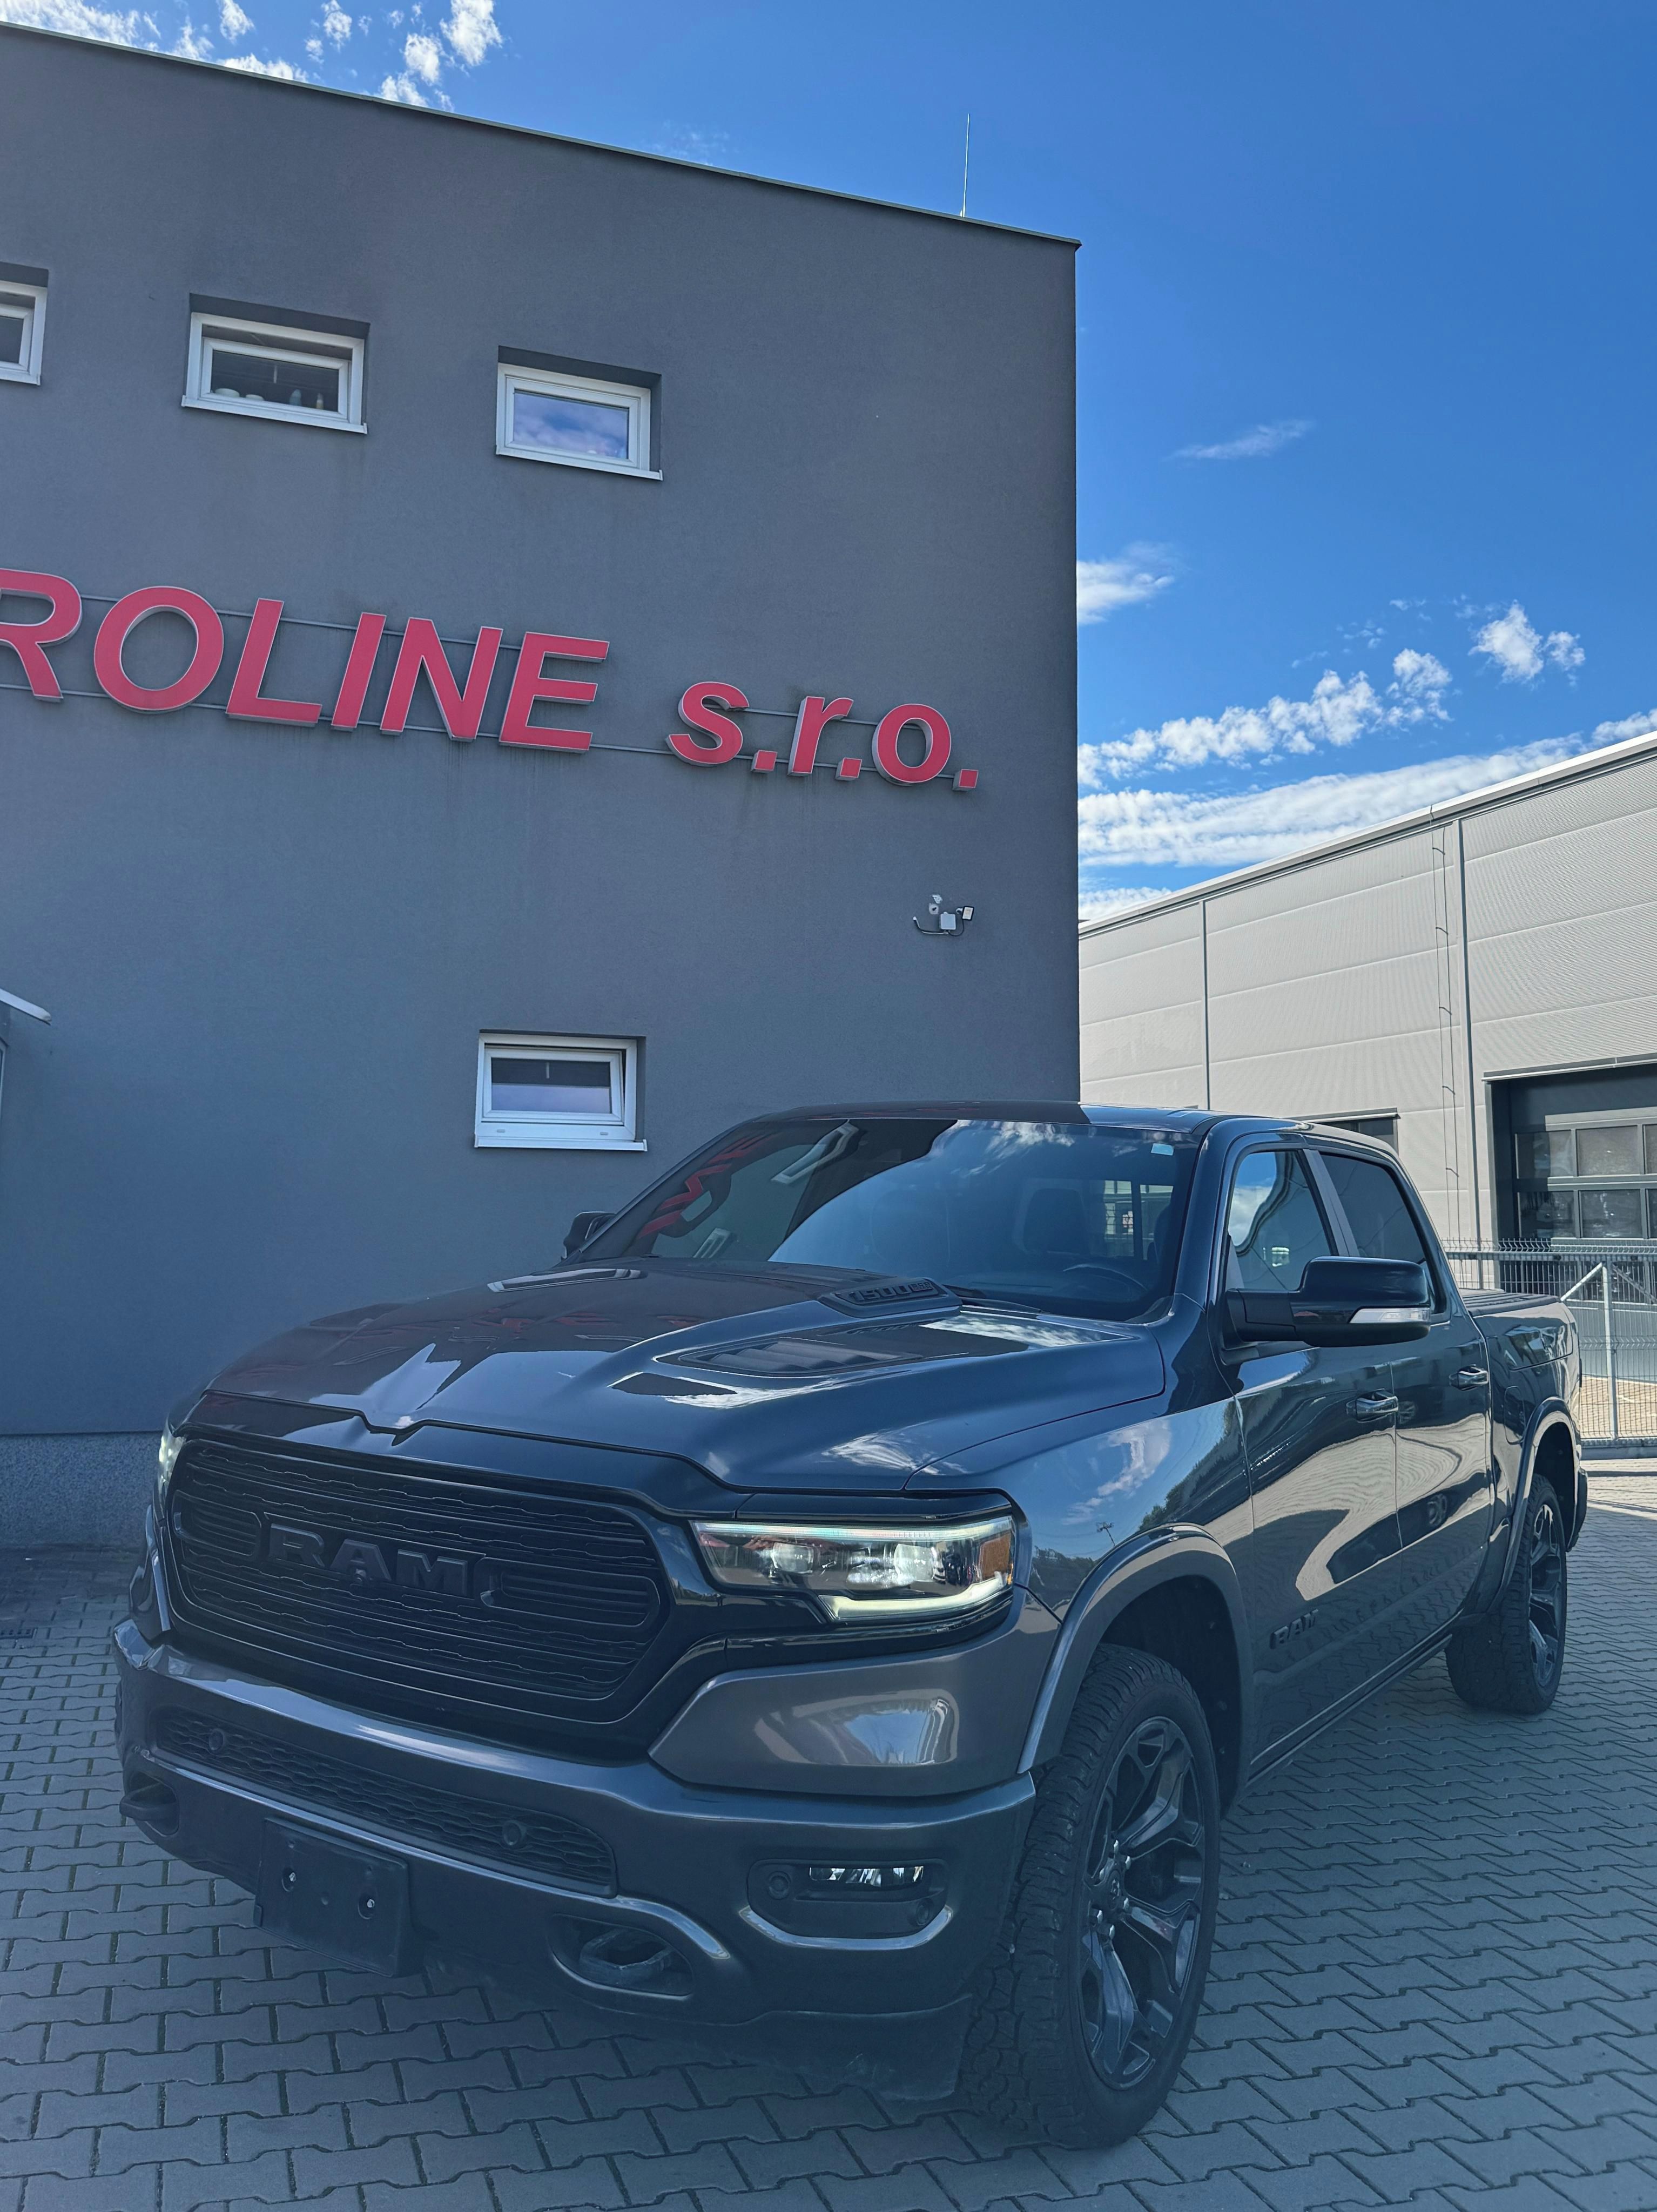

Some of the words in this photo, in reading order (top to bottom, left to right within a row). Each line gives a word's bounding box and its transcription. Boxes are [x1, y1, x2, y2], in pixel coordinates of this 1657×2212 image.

[0, 568, 610, 753] ROLINE
[666, 681, 979, 791] s.r.o.
[849, 1285, 911, 1301] 1500
[270, 1523, 467, 1595] RAM
